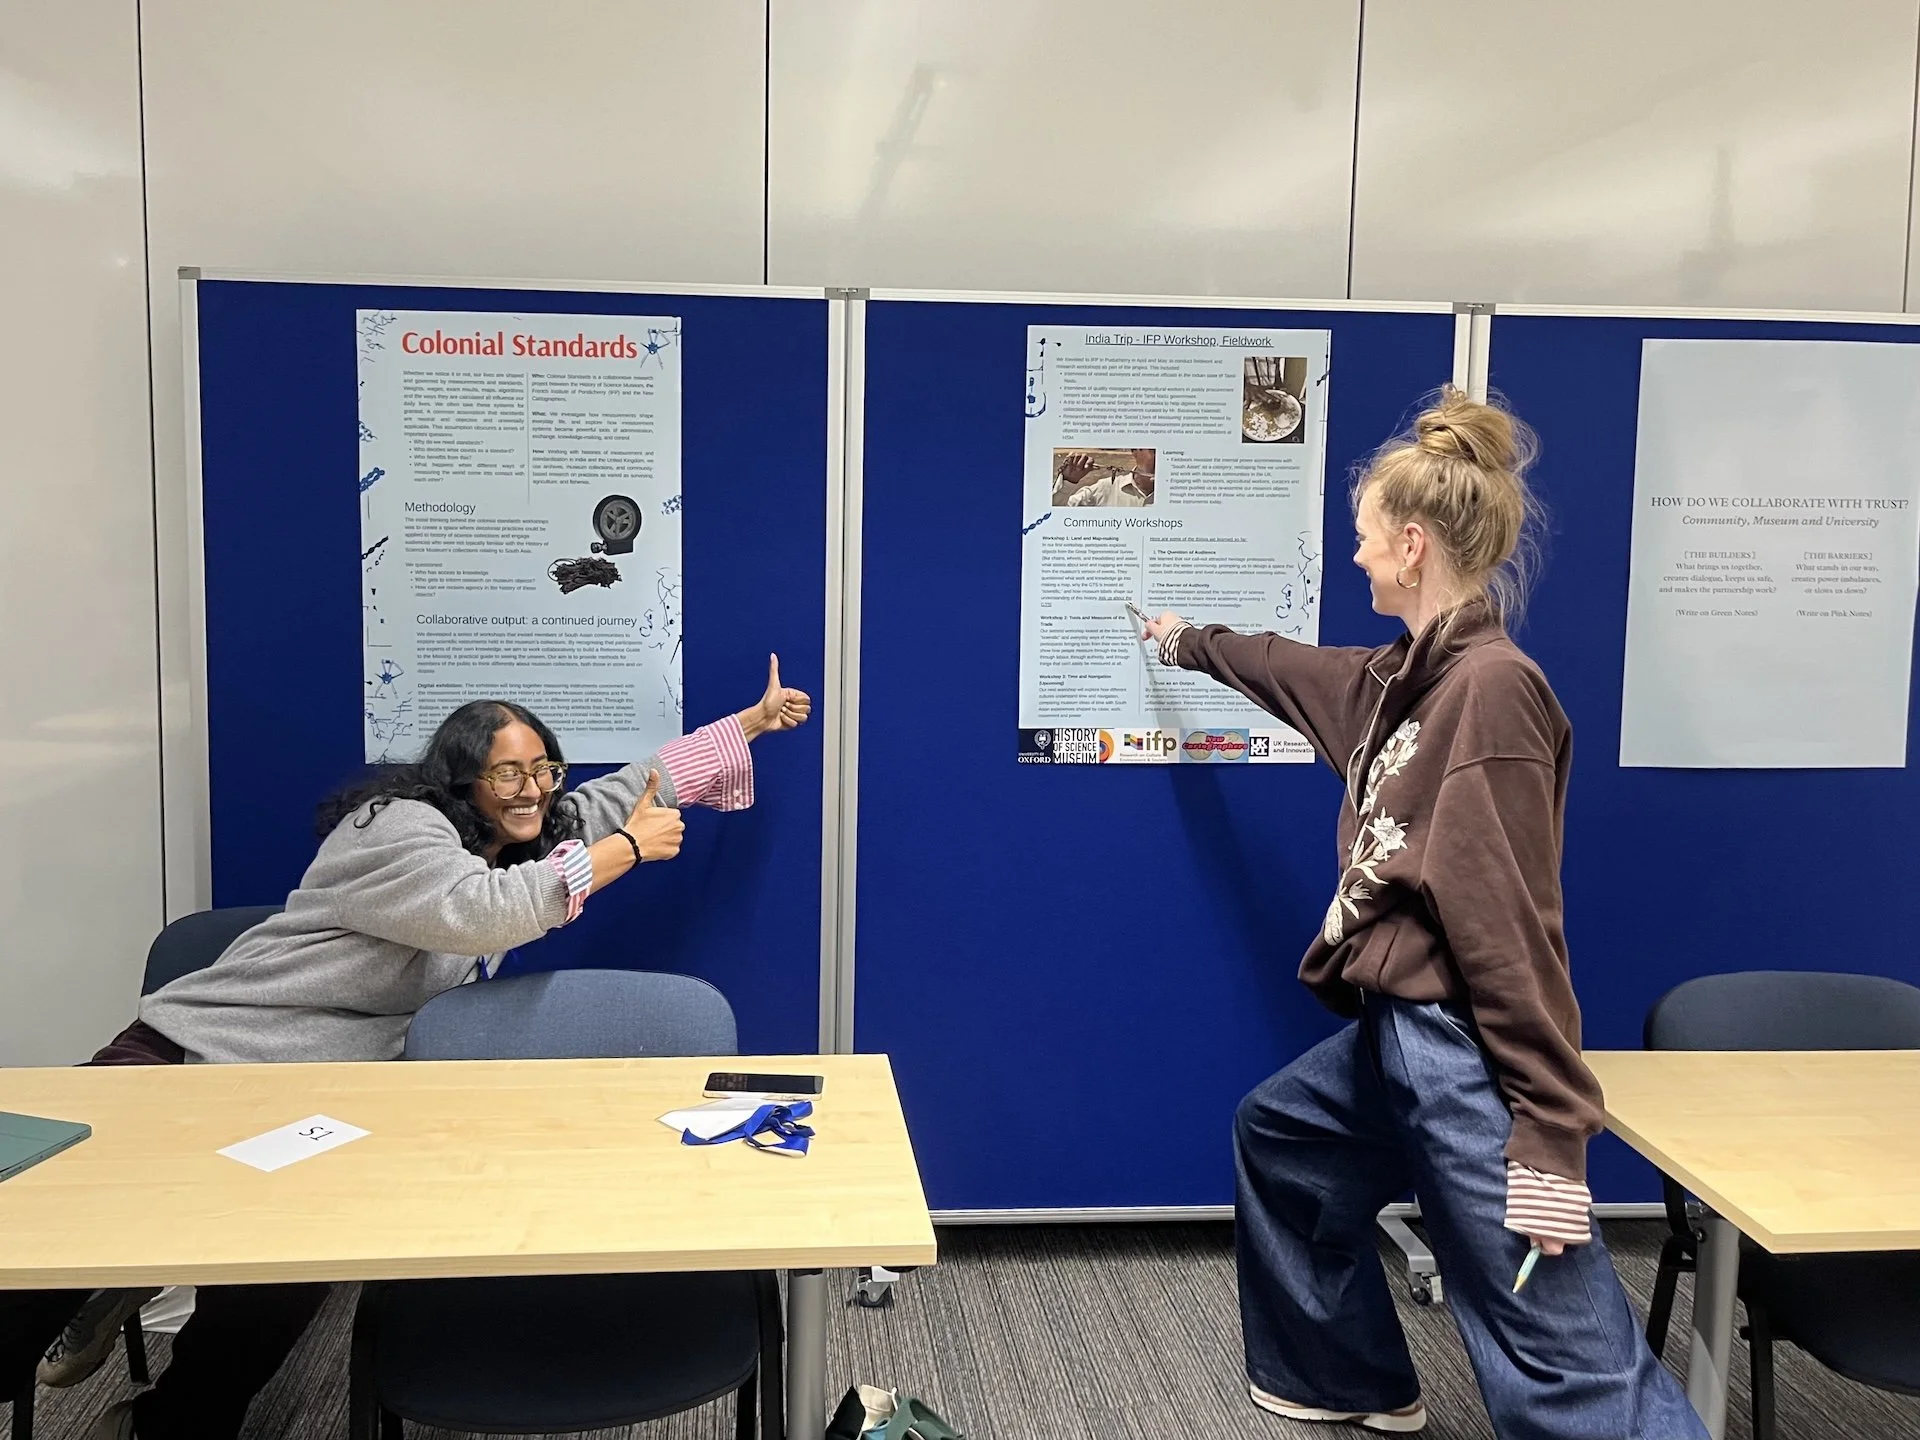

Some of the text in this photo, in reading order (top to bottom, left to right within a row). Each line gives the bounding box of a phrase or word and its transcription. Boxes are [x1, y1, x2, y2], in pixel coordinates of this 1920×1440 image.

[402, 329, 638, 358] Colonial Standards
[1085, 332, 1111, 344] India
[1114, 333, 1133, 346] Trip
[1143, 333, 1161, 344] IFP
[1164, 333, 1219, 347] Workshop,
[1222, 335, 1272, 346] Fieldwork
[404, 500, 476, 515] Methodology
[1650, 496, 1909, 509] HOW DO WE COLLABORATE WITH TRUST?
[1063, 517, 1183, 530] Community Workshops
[1682, 514, 1880, 529] Community, Museum and University
[416, 613, 637, 628] Collaborative output: a continued journey
[1053, 728, 1097, 741] HISTORY
[1053, 742, 1097, 751] OF SCIENCE
[1146, 730, 1177, 756] ifp
[1053, 752, 1097, 764] MUSEUM
[299, 1126, 334, 1141] S1
